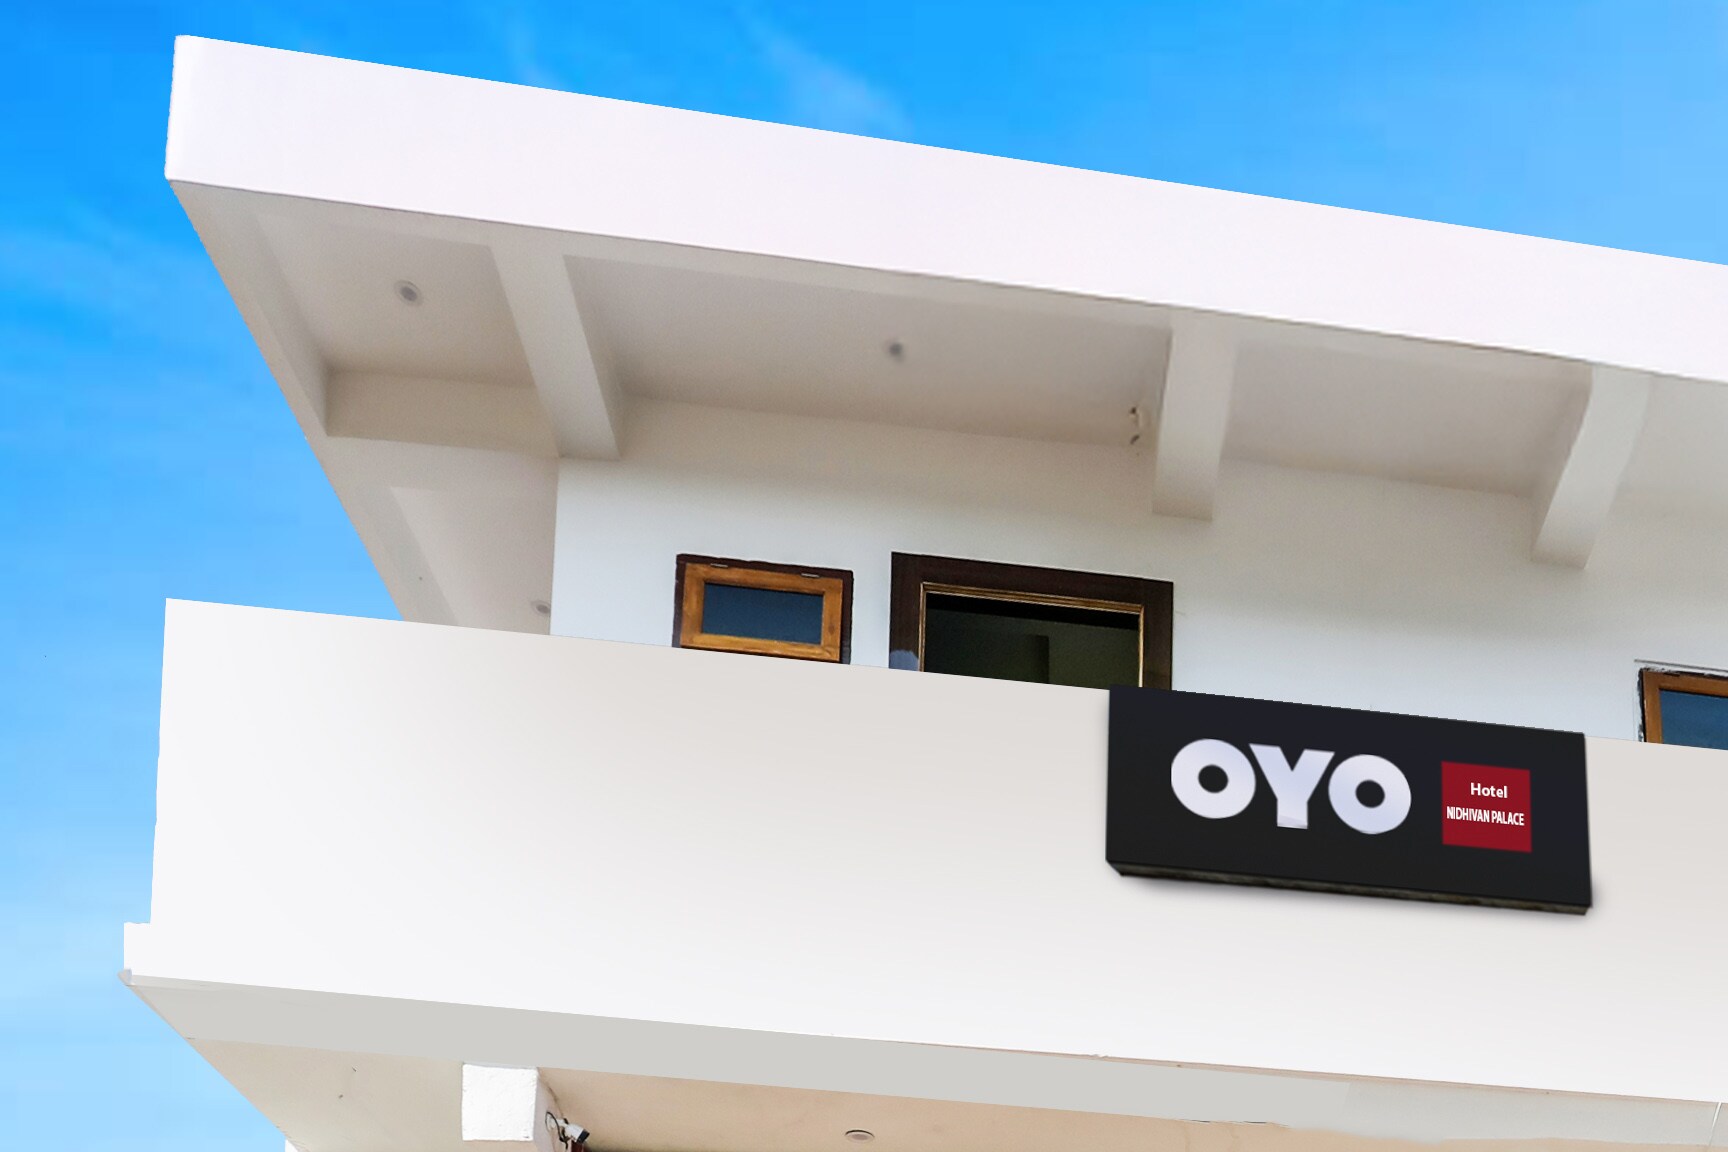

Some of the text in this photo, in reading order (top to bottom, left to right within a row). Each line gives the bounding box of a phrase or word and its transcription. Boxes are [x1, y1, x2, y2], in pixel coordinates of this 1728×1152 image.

[1171, 738, 1412, 835] OYO
[1470, 782, 1508, 799] Hotel
[1446, 805, 1525, 826] NIDHIVAN PALACE
